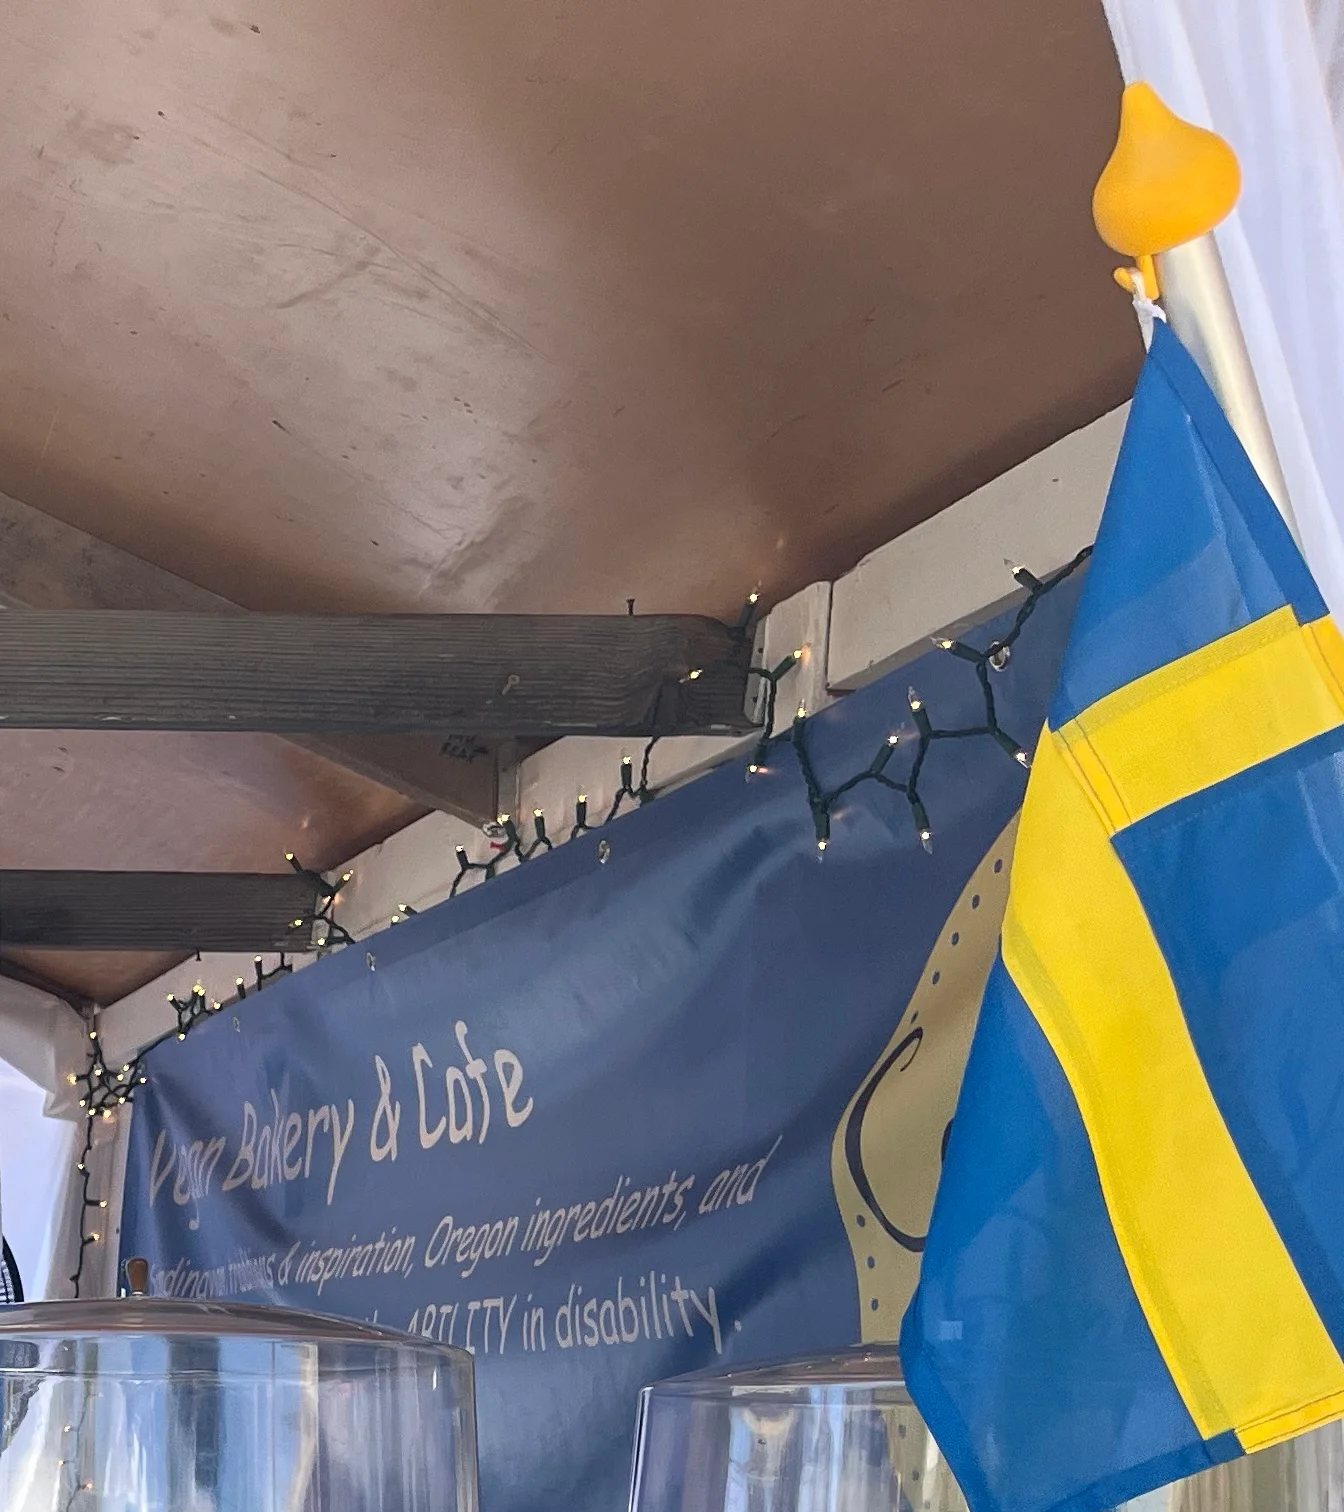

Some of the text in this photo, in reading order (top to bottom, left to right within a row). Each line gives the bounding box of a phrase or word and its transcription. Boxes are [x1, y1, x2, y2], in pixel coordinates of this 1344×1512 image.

[222, 1088, 355, 1206] Bakery
[370, 1055, 401, 1162] &
[412, 1020, 534, 1149] Cafe
[295, 1226, 417, 1297] inspiration,
[424, 1215, 520, 1279] Oregon
[521, 1170, 696, 1267] ingredients,
[698, 1135, 783, 1214] and
[522, 1292, 547, 1352] in
